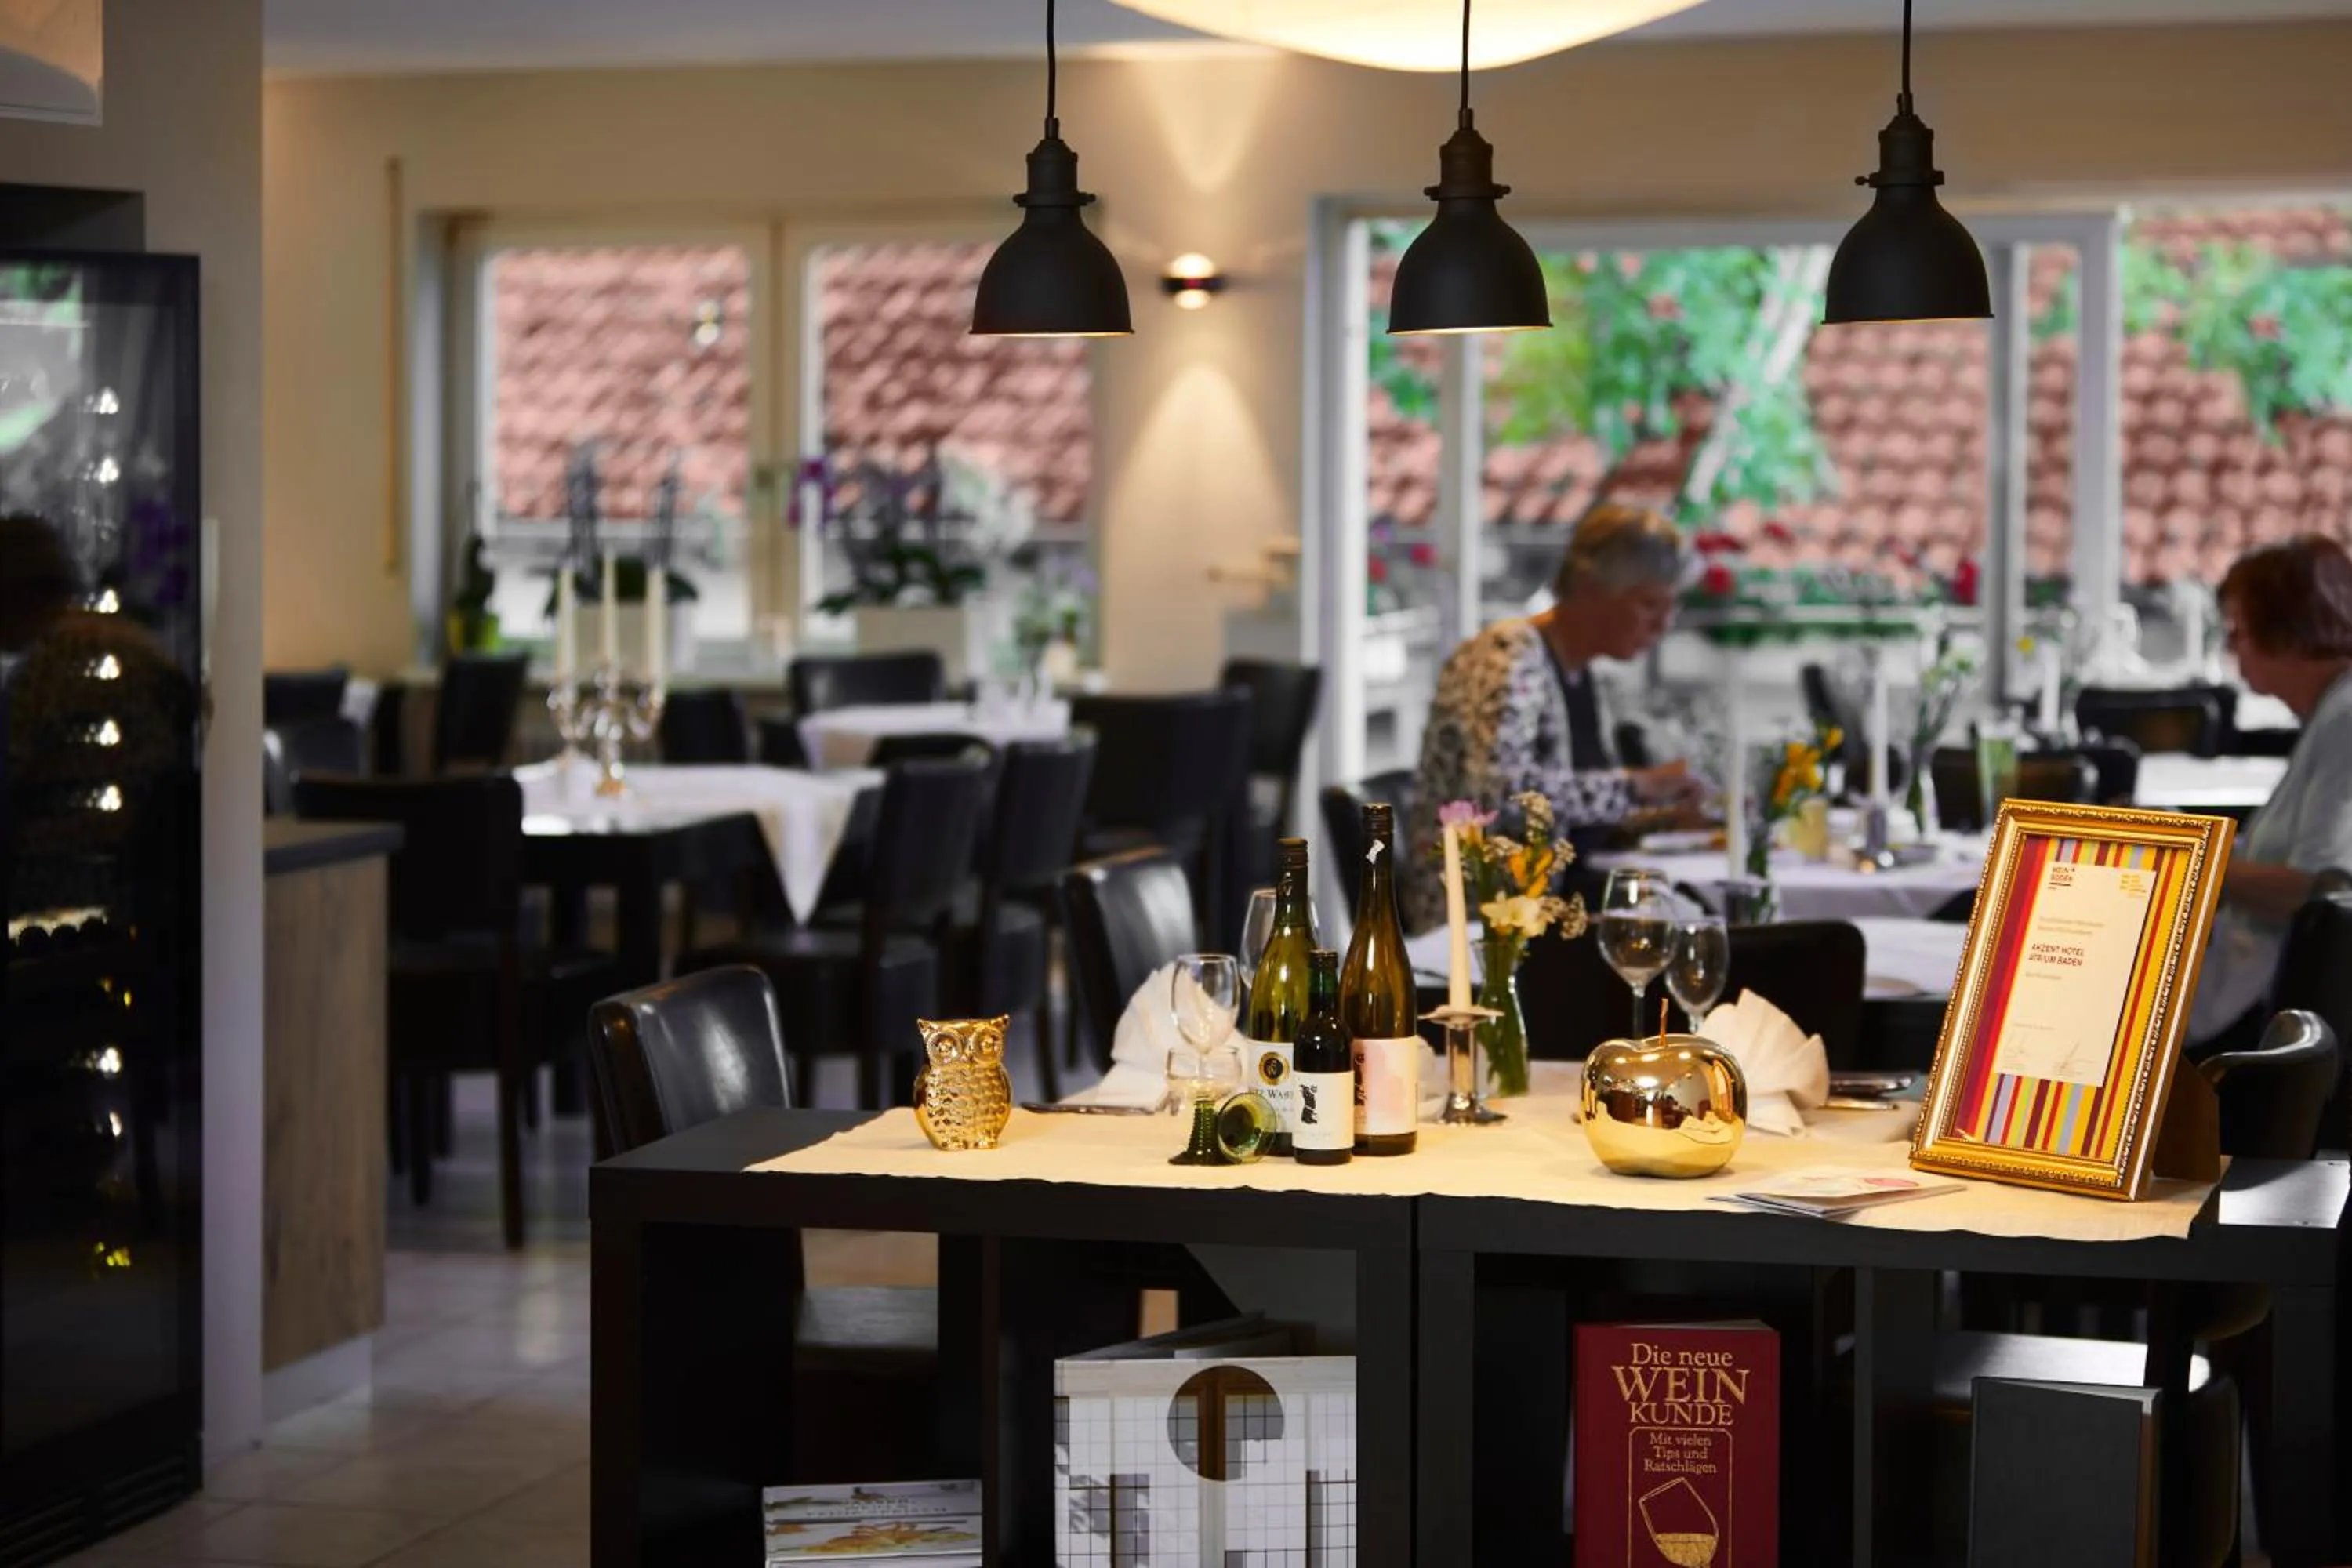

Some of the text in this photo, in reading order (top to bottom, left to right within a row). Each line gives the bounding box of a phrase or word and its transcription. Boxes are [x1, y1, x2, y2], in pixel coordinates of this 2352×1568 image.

[2061, 947, 2083, 956] HOTEL
[2057, 956, 2082, 966] BADEN
[1631, 1343, 1733, 1367] Die neue
[1611, 1366, 1751, 1406] WEIN
[1629, 1402, 1734, 1425] KUNDE
[1650, 1432, 1712, 1446] Mit vielen
[1654, 1446, 1708, 1460] Tips und
